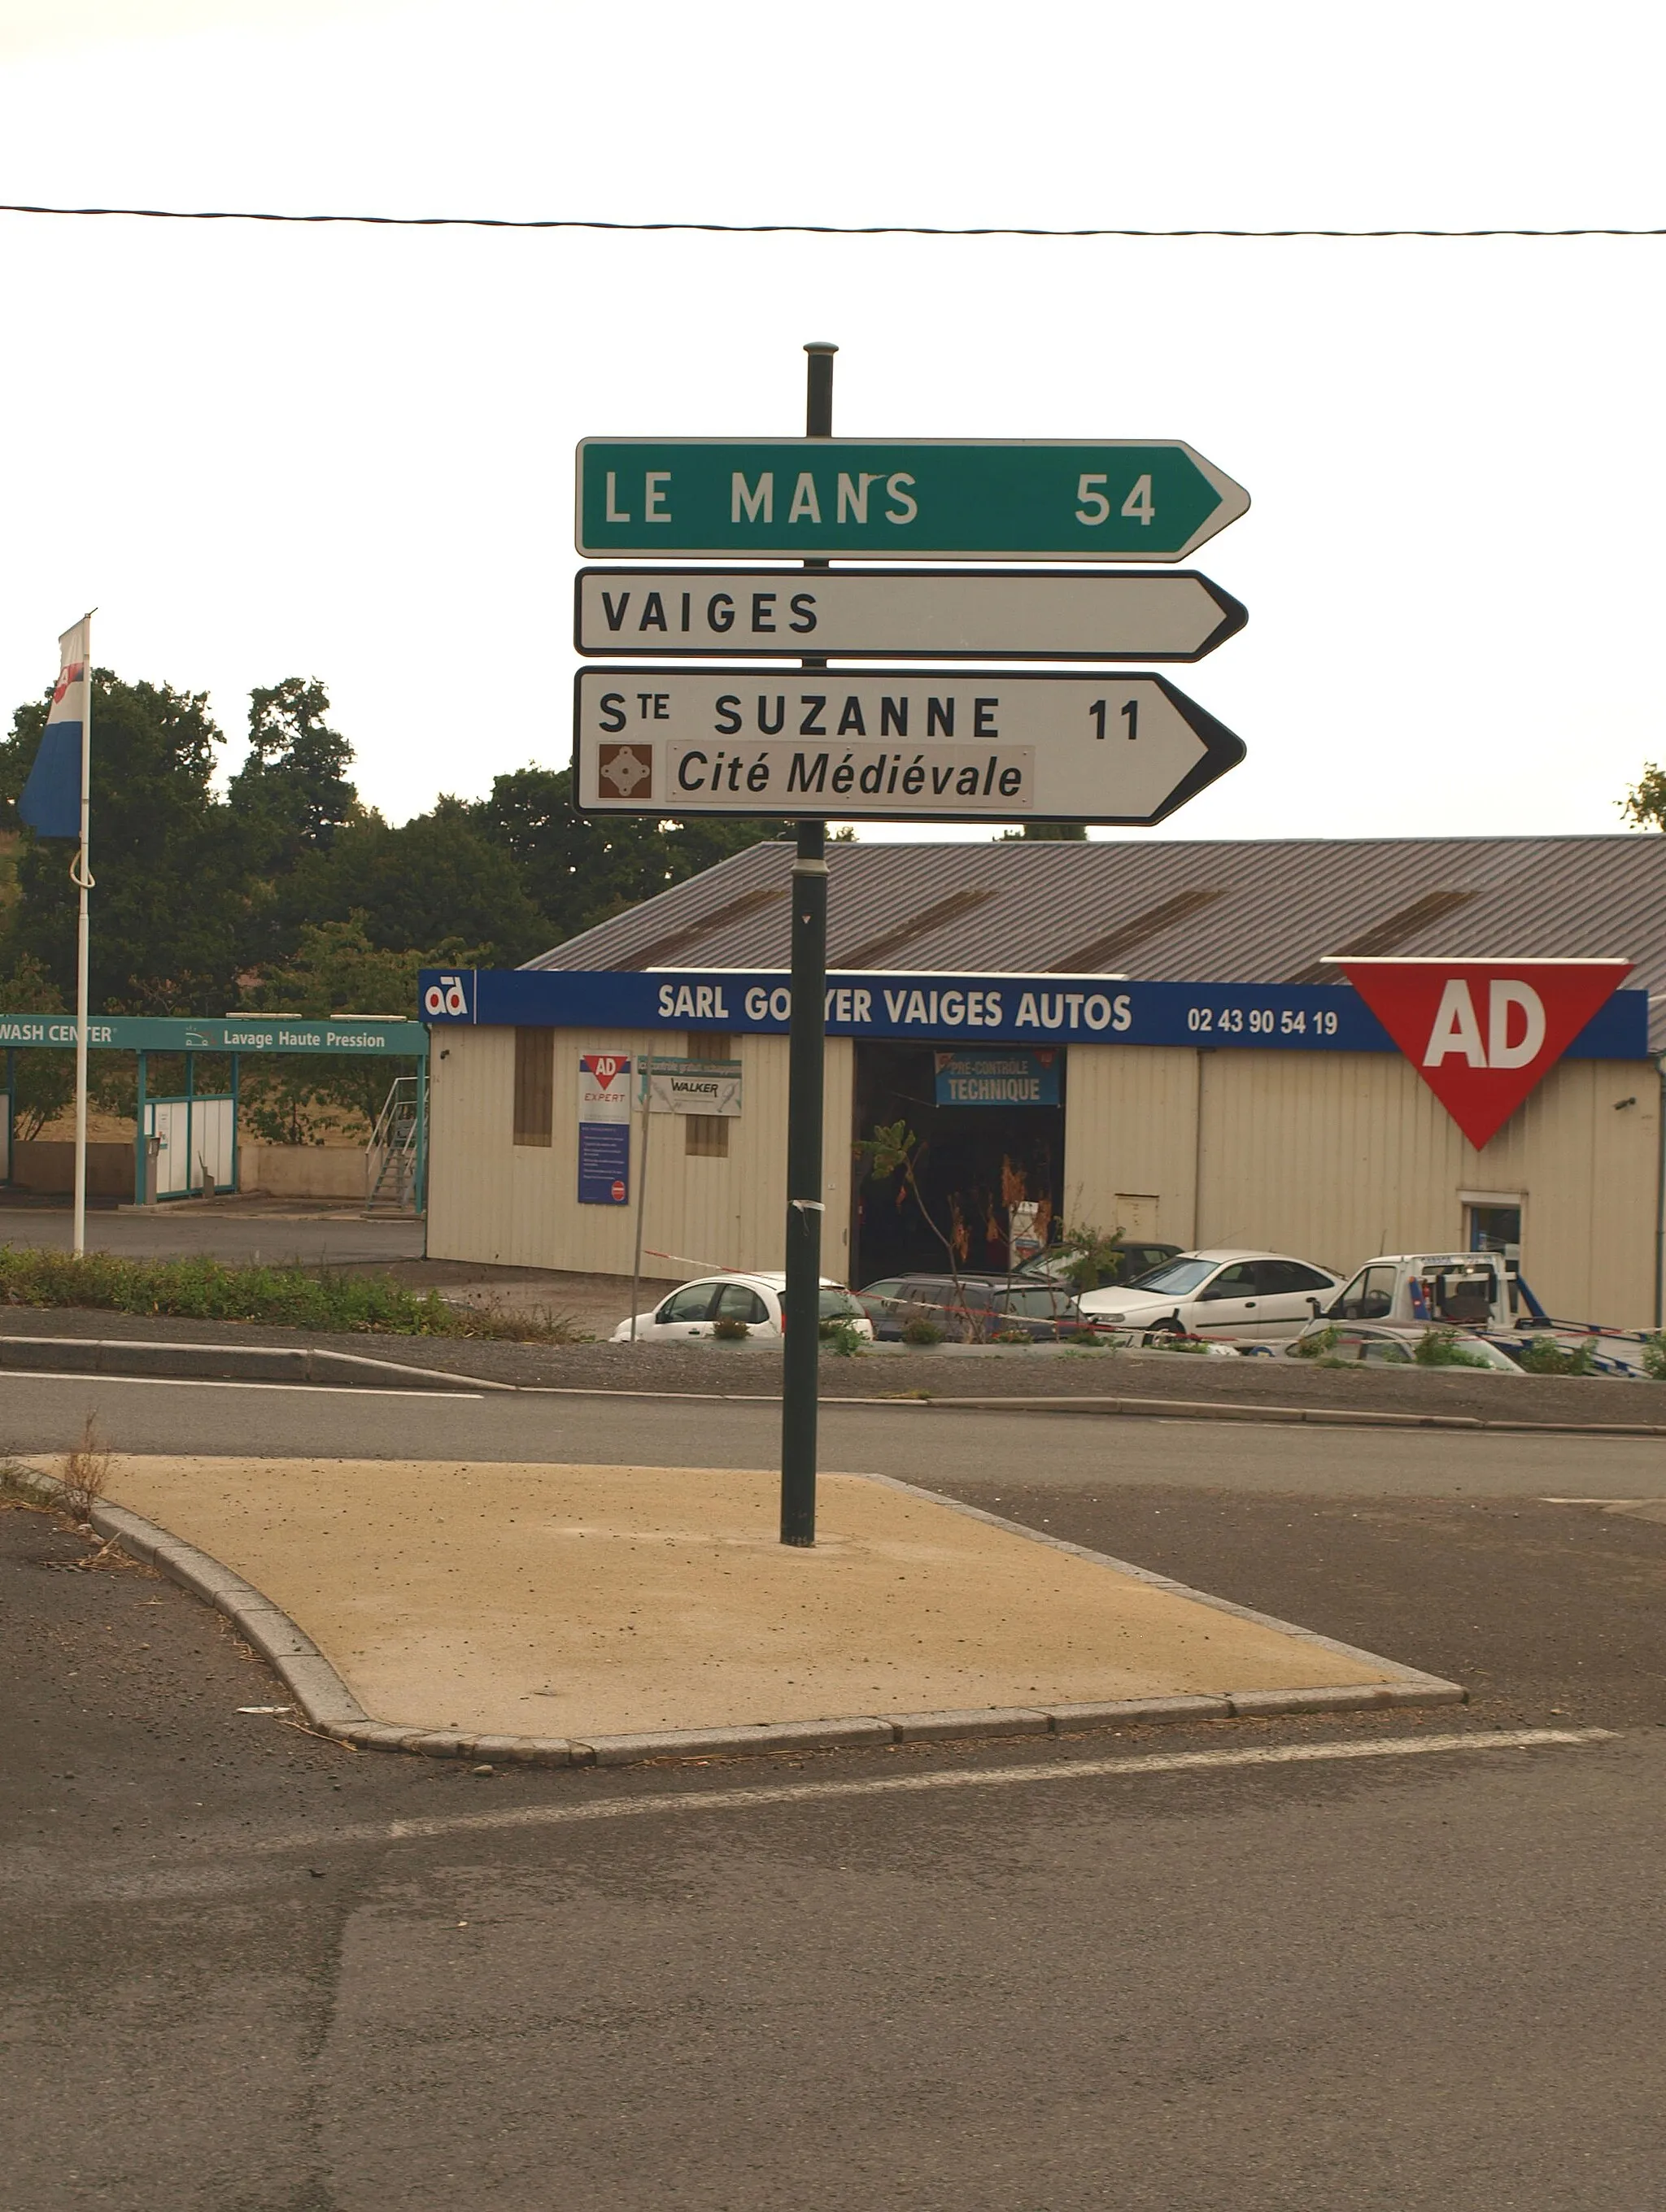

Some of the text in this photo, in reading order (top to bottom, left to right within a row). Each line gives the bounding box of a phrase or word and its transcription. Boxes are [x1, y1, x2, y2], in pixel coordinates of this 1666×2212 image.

[606, 472, 1155, 526] LE MANS 54
[601, 591, 818, 634] VAIGES
[714, 695, 1000, 738] SUZANNE
[1088, 699, 1138, 740] 11
[678, 751, 1023, 797] Cité Médiévale
[657, 983, 1133, 1031] SARL GOYER VAIGES AUTOS
[0, 1024, 45, 1041] WASH
[1188, 1008, 1339, 1035] 02 43 90 54 19
[1422, 978, 1547, 1069] AD
[224, 1029, 386, 1049] Lavage Haute Pression
[595, 1058, 616, 1077] AD
[584, 1092, 626, 1103] EXPERT
[670, 1078, 719, 1098] WALKER
[949, 1078, 1041, 1102] TECHNIQUE
